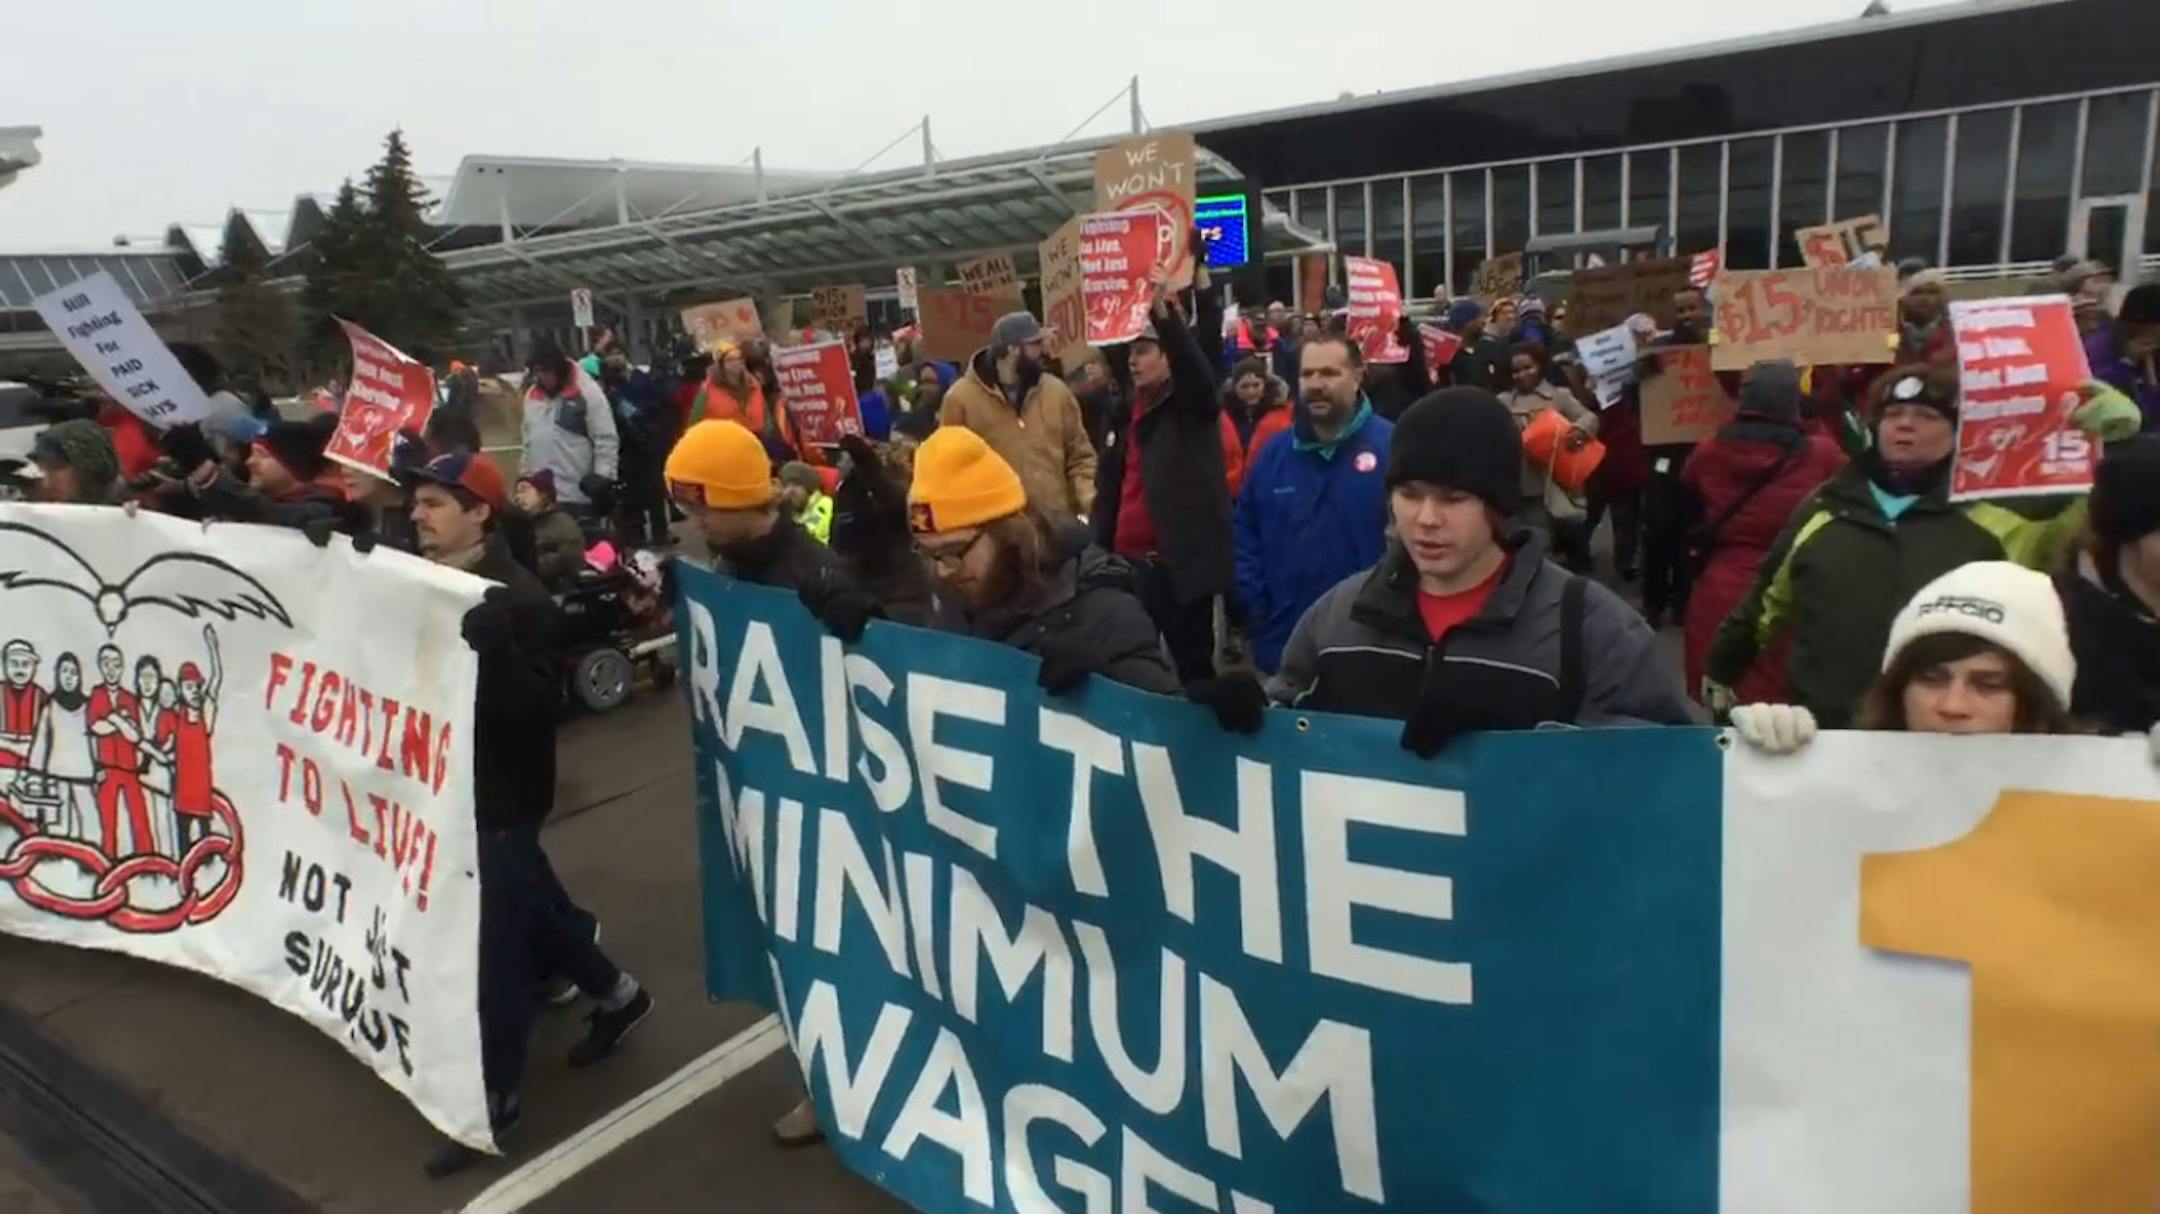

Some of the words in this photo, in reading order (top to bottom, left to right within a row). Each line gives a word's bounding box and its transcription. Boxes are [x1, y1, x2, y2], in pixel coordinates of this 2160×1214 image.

[1107, 162, 1185, 199] WON'T
[1126, 142, 1159, 166] WE
[1718, 274, 1805, 344] $15
[111, 358, 144, 379] PAID
[2045, 430, 2090, 461] 15
[265, 652, 453, 797] FIGHTING
[276, 743, 323, 817] TO
[340, 778, 438, 912] LIVE!
[686, 595, 1007, 861] RAISE
[1039, 706, 1474, 1006] THE
[279, 850, 352, 925] NOT
[714, 758, 1385, 1206] MINIMUM
